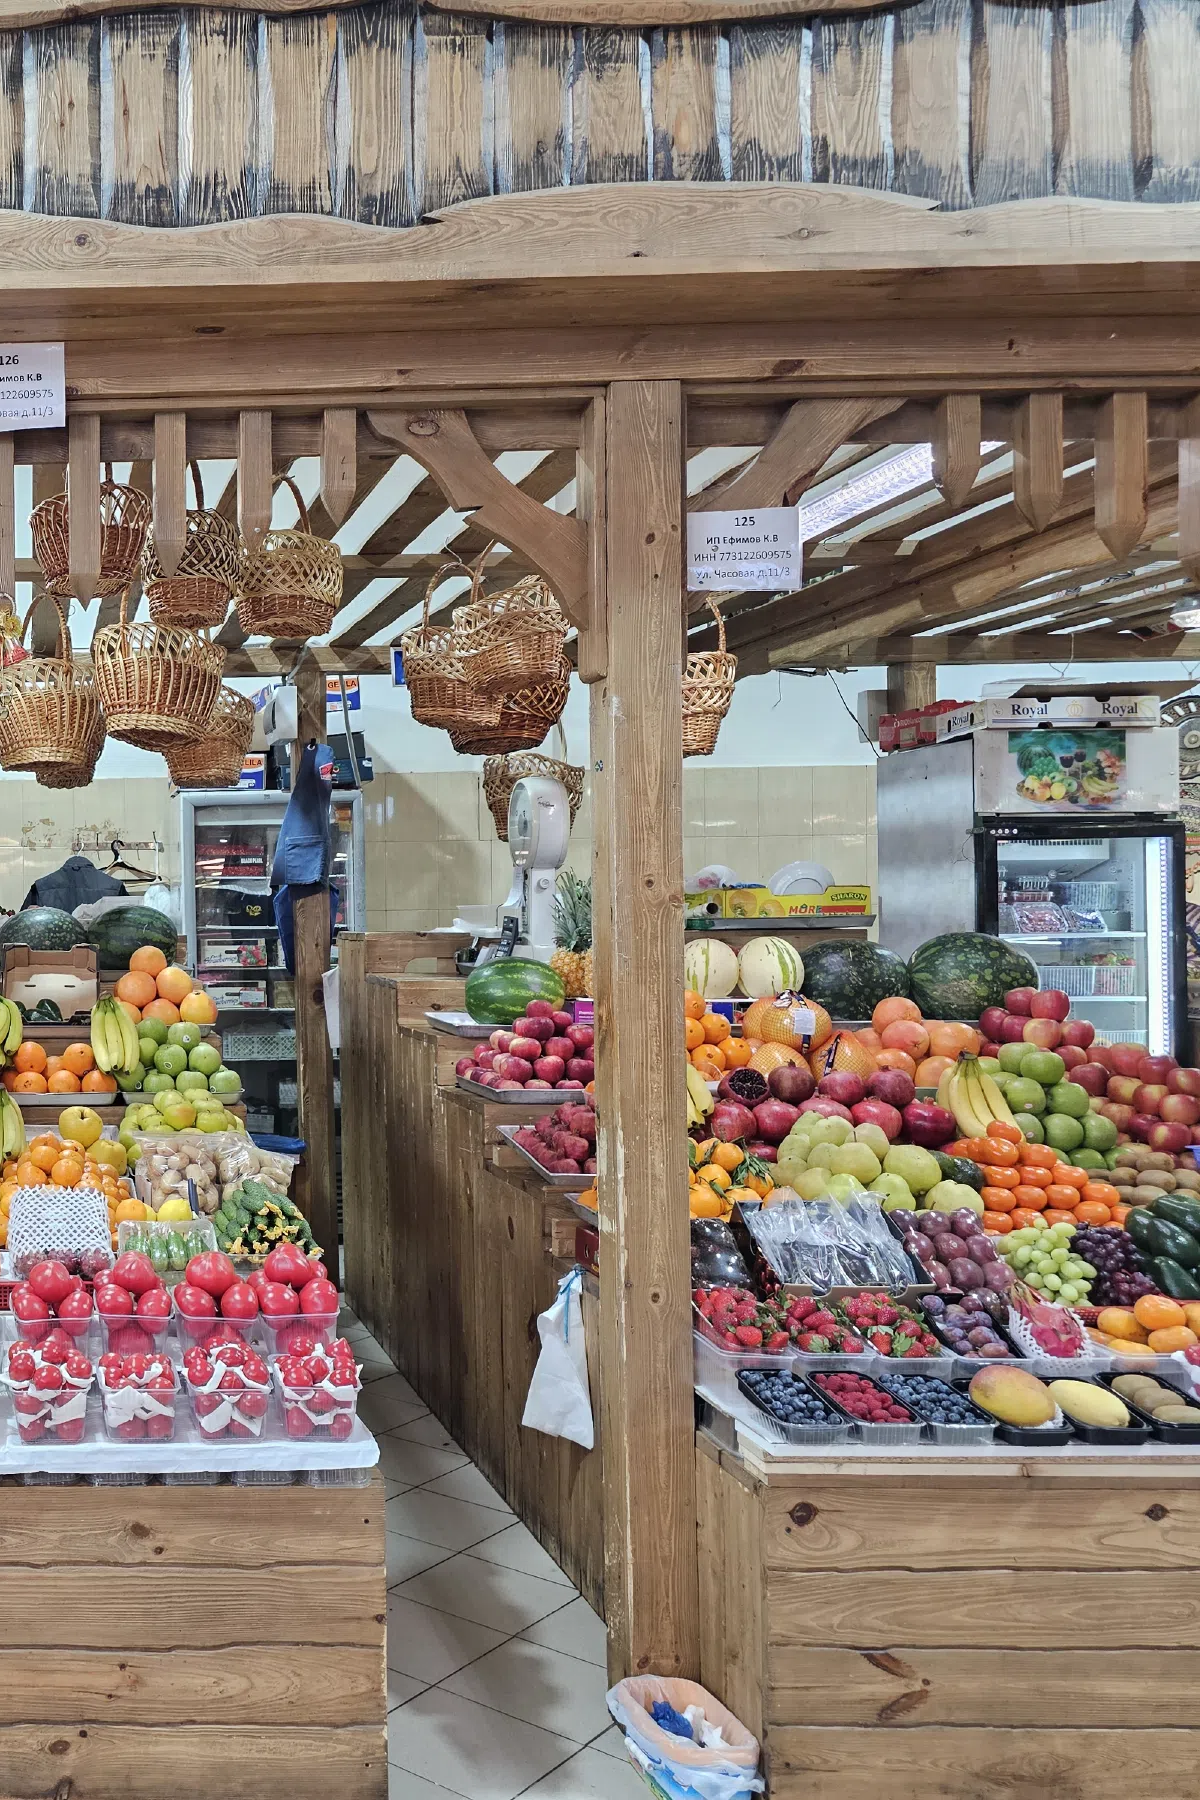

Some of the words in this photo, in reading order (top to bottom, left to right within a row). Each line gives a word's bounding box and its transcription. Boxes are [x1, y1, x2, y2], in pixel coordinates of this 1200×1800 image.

[21, 406, 54, 418] д.11/3
[734, 516, 756, 527] 125
[706, 536, 721, 545] ИП
[722, 535, 761, 546] Ефимов
[694, 552, 716, 562] ИНН
[696, 570, 712, 580] Ул.
[714, 569, 755, 579] Часовая
[757, 567, 790, 579] д.11/3
[327, 679, 357, 689] GELA
[1011, 703, 1048, 718] Royal
[1101, 702, 1138, 717] Royal
[952, 711, 970, 728] Royal
[830, 892, 868, 902] SHARON
